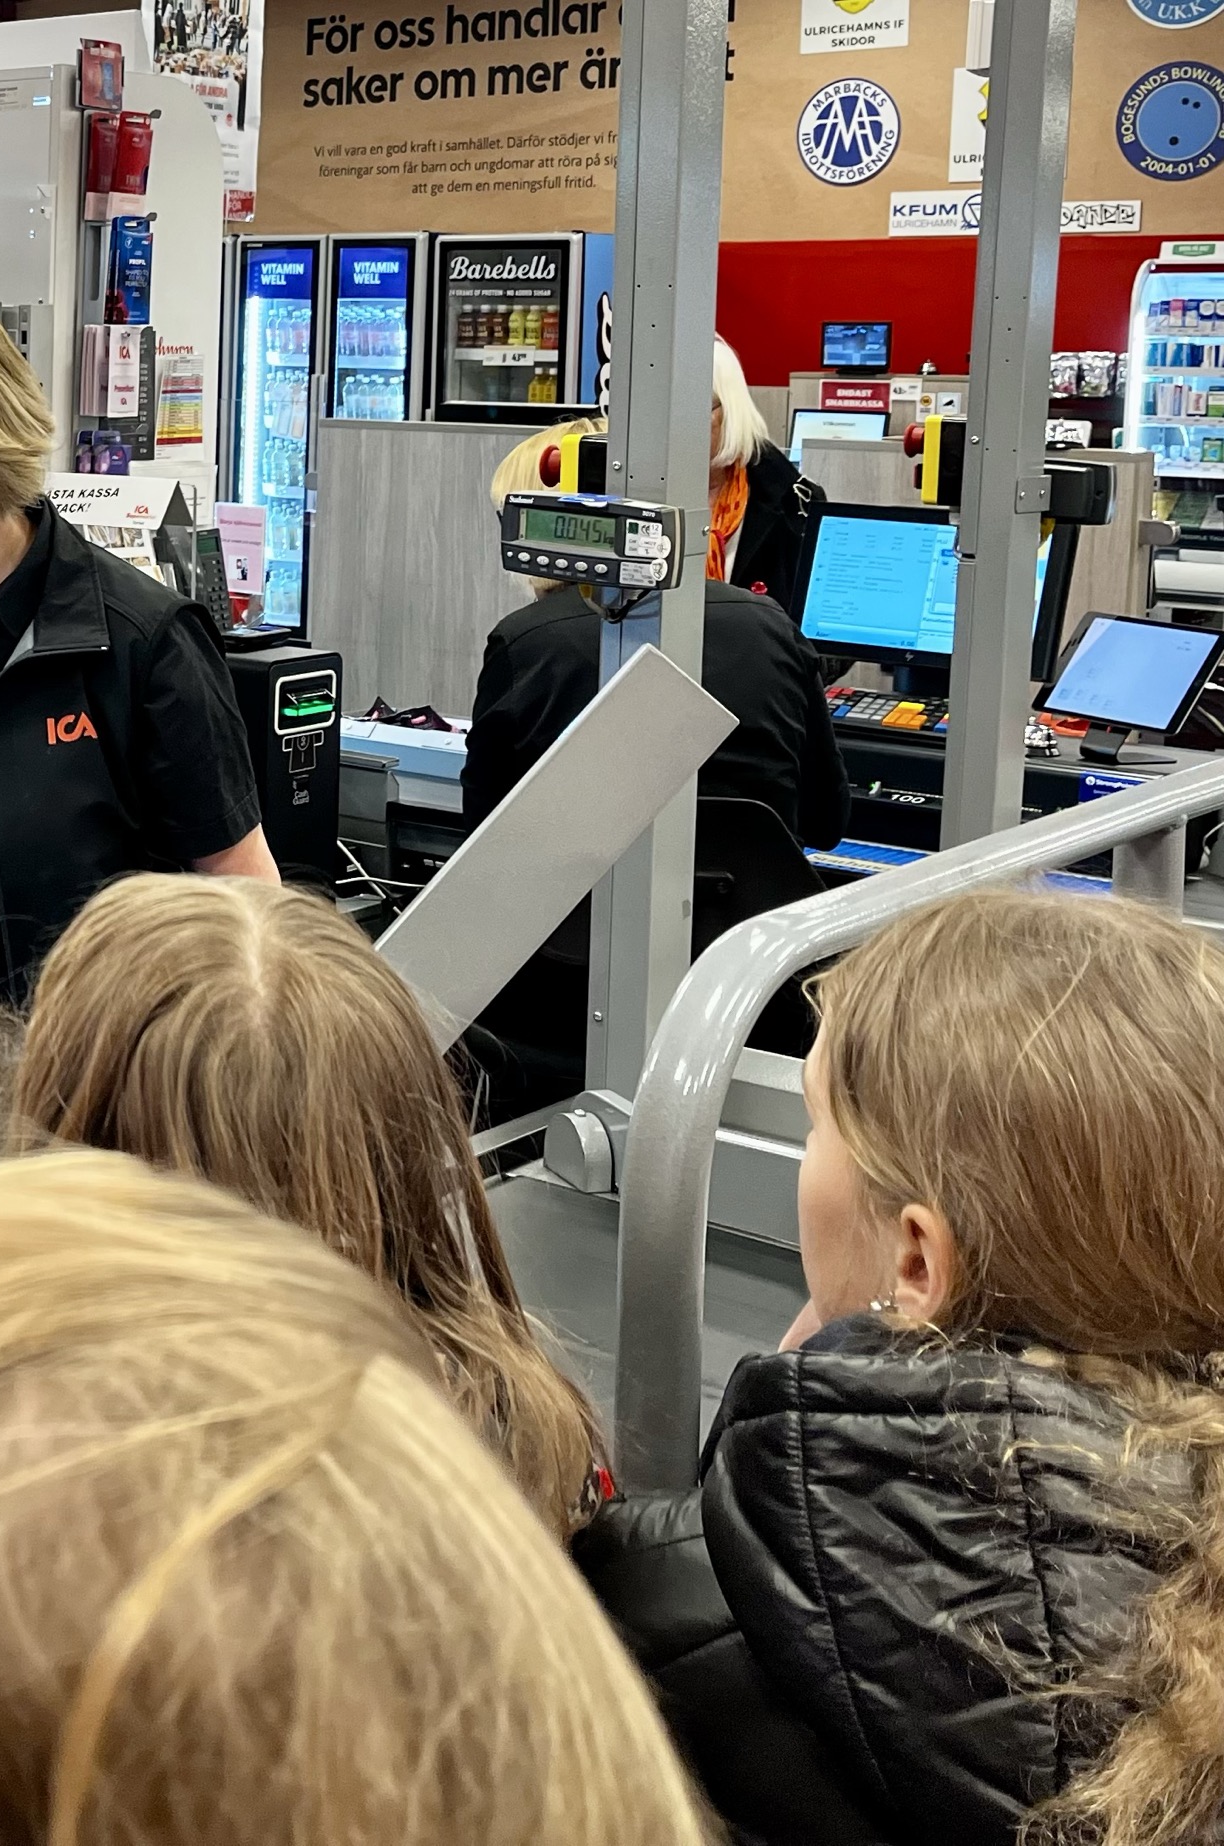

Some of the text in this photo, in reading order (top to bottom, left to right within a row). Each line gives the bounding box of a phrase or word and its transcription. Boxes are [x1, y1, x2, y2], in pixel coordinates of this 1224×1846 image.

[306, 0, 607, 55] För oss handlar
[804, 19, 905, 36] ULRICEHAMNS IF
[831, 36, 875, 47] SKIDOR
[303, 66, 405, 107] saker
[414, 68, 475, 100] om
[488, 61, 569, 96] mer
[812, 82, 888, 112] MARBÄCKS
[1121, 70, 1169, 144] BOGESUNDS
[314, 146, 324, 157] Vi
[327, 145, 342, 157] vill
[344, 147, 367, 157] vara
[370, 145, 383, 155] en
[386, 141, 407, 158] god
[410, 139, 436, 153] kraft
[446, 138, 504, 151] samhället.
[507, 135, 545, 149] Därför
[548, 133, 590, 149] stödjer
[593, 132, 604, 144] vi
[802, 129, 895, 180] IDROTTSFÖRENING
[319, 164, 373, 179] föreningar
[376, 165, 400, 175] som
[403, 161, 419, 174] får
[421, 161, 447, 173] barn
[450, 159, 471, 172] och
[474, 158, 535, 173] ungdomar
[538, 158, 554, 168] att
[558, 155, 582, 168] röra
[586, 153, 600, 169] på
[1140, 153, 1216, 174] 2004-01-01
[412, 175, 597, 197] att ge dem en meningsfull fritid.
[893, 204, 958, 216] KFUM
[892, 219, 957, 229] ULRICEHAMN
[261, 263, 304, 275] VITAMIN
[353, 261, 400, 273] VITAMIN
[449, 256, 556, 280] Barebells
[261, 274, 287, 285] WELL
[353, 273, 381, 284] WELL
[119, 345, 130, 359] ICA
[836, 389, 873, 397] ENDAST
[825, 399, 884, 408] SNABBKASSA
[78, 488, 120, 498] KASSA
[56, 503, 91, 513] TACK!
[134, 505, 149, 514] ICA
[554, 515, 603, 543] 0.045
[46, 711, 97, 745] ICA
[891, 794, 925, 804] 100
